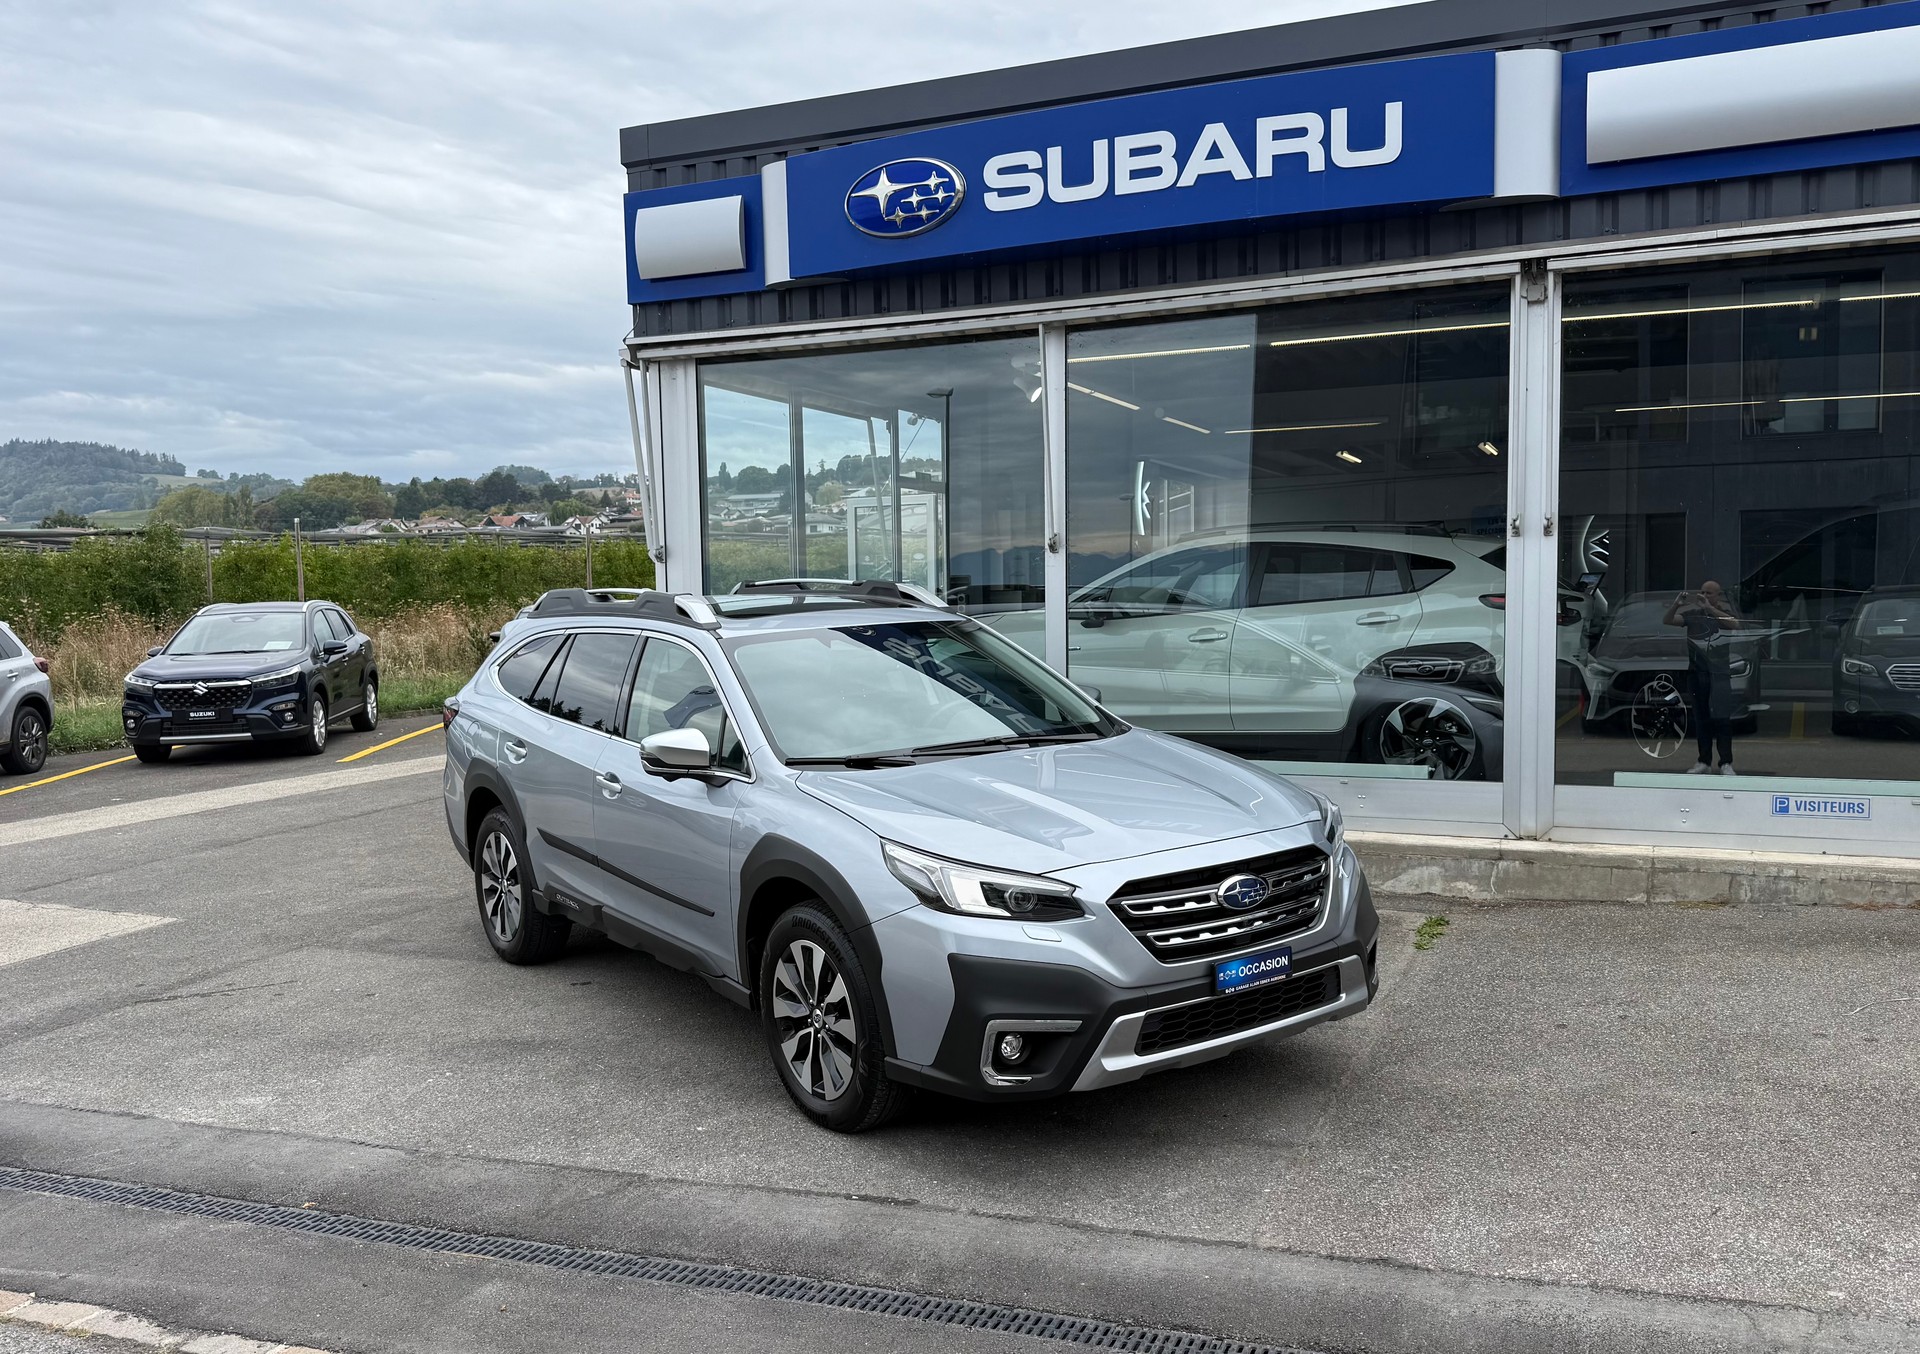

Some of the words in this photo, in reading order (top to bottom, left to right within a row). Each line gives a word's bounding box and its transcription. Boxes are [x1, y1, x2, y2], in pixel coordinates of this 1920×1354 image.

[983, 101, 1403, 212] SUBARU
[1776, 798, 1788, 812] P
[1795, 800, 1865, 814] VISITEURS
[791, 915, 846, 966] BRIDGESTONE
[1238, 955, 1289, 977] OCCASION
